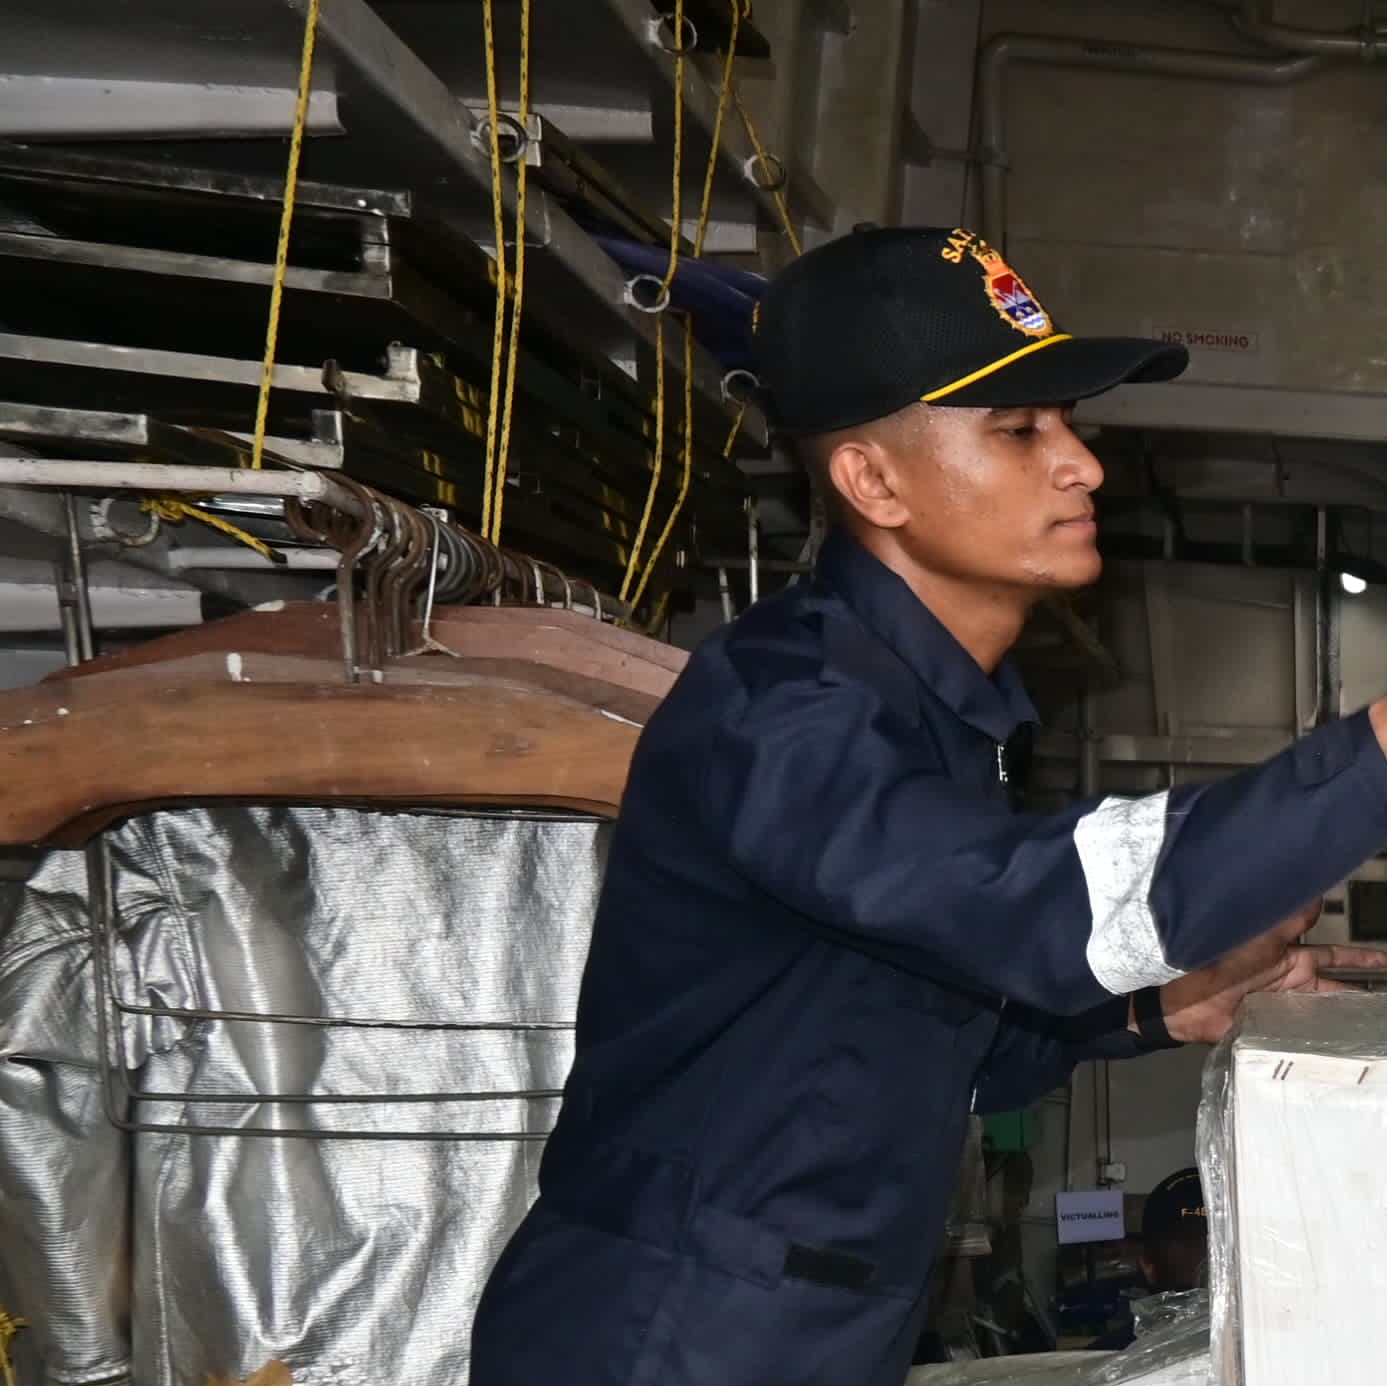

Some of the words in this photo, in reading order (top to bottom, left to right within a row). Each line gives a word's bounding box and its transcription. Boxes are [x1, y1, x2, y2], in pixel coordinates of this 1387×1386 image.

[1161, 331, 1182, 345] NO
[1186, 332, 1249, 349] SMOKING
[1061, 1210, 1120, 1221] VICTUALLING
